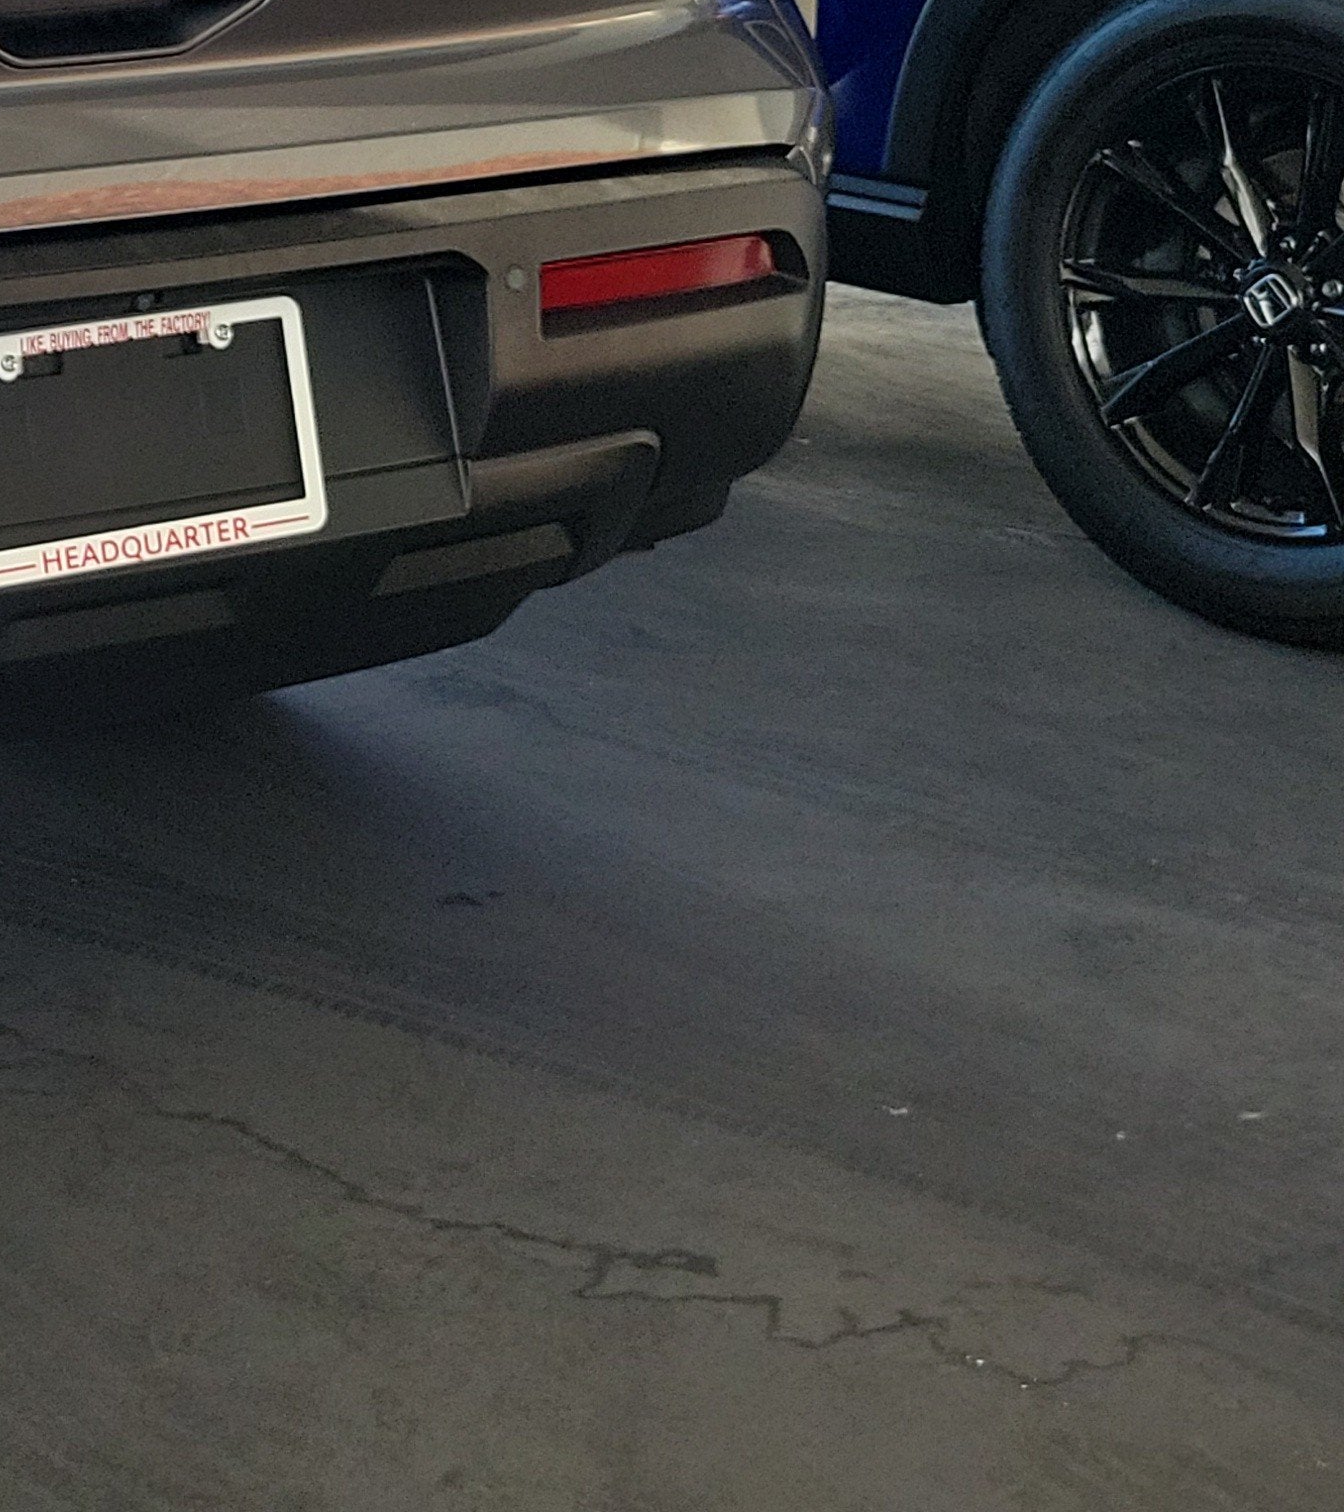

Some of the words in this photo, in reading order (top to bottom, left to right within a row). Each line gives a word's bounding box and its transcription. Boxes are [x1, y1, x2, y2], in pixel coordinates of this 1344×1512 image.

[20, 335, 45, 355] LIKE
[49, 329, 92, 351] BUYING
[97, 322, 128, 344] FROM
[135, 318, 155, 338] THE
[41, 516, 250, 574] HEADQUARTER
